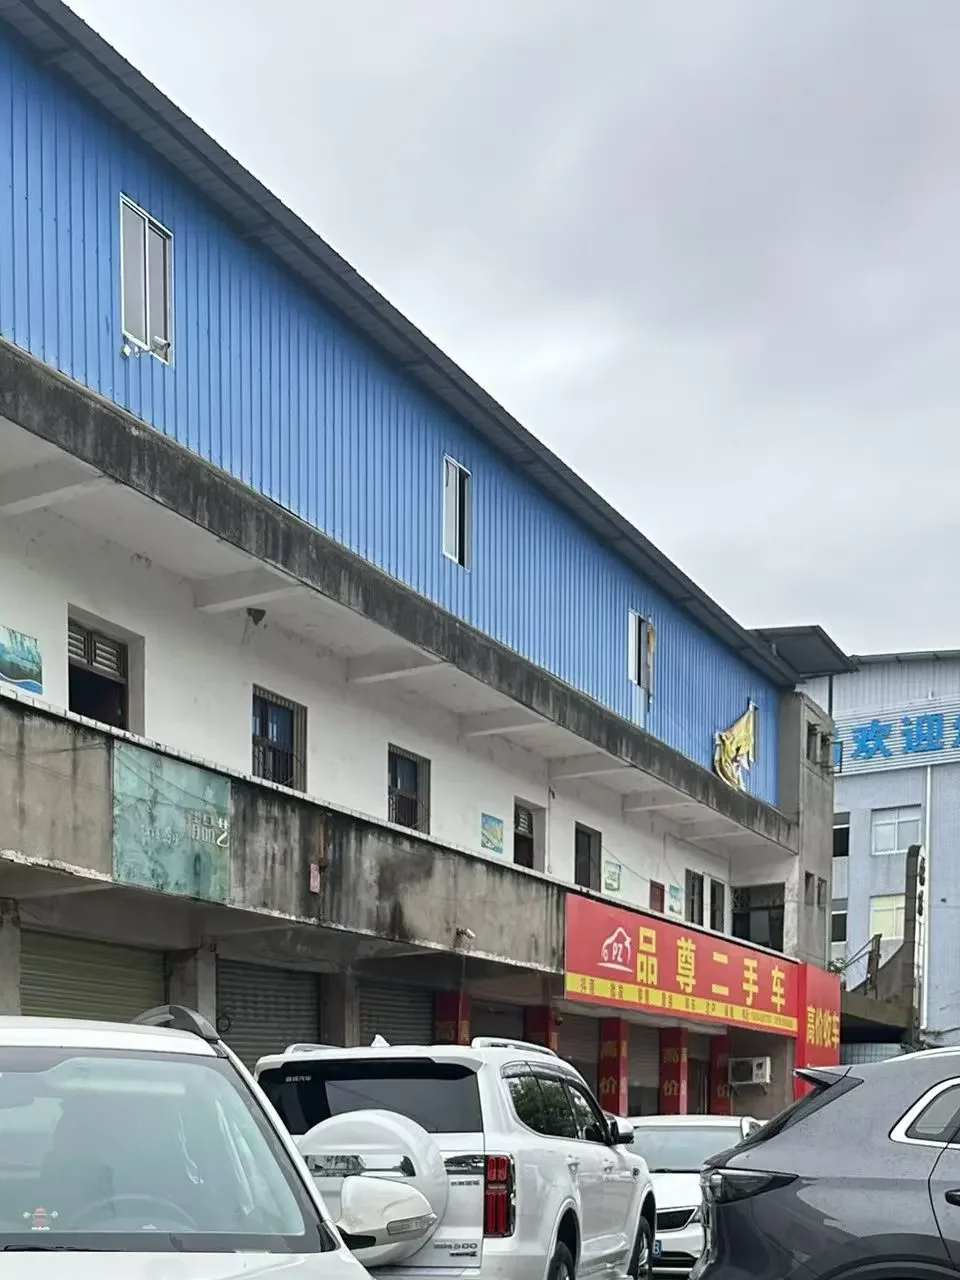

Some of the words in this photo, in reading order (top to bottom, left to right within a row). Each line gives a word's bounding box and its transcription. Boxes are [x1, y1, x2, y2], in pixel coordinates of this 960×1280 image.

[851, 712, 960, 760] 欢迎
[636, 926, 786, 1012] 品尊二手车
[806, 1004, 839, 1049] 高价收车
